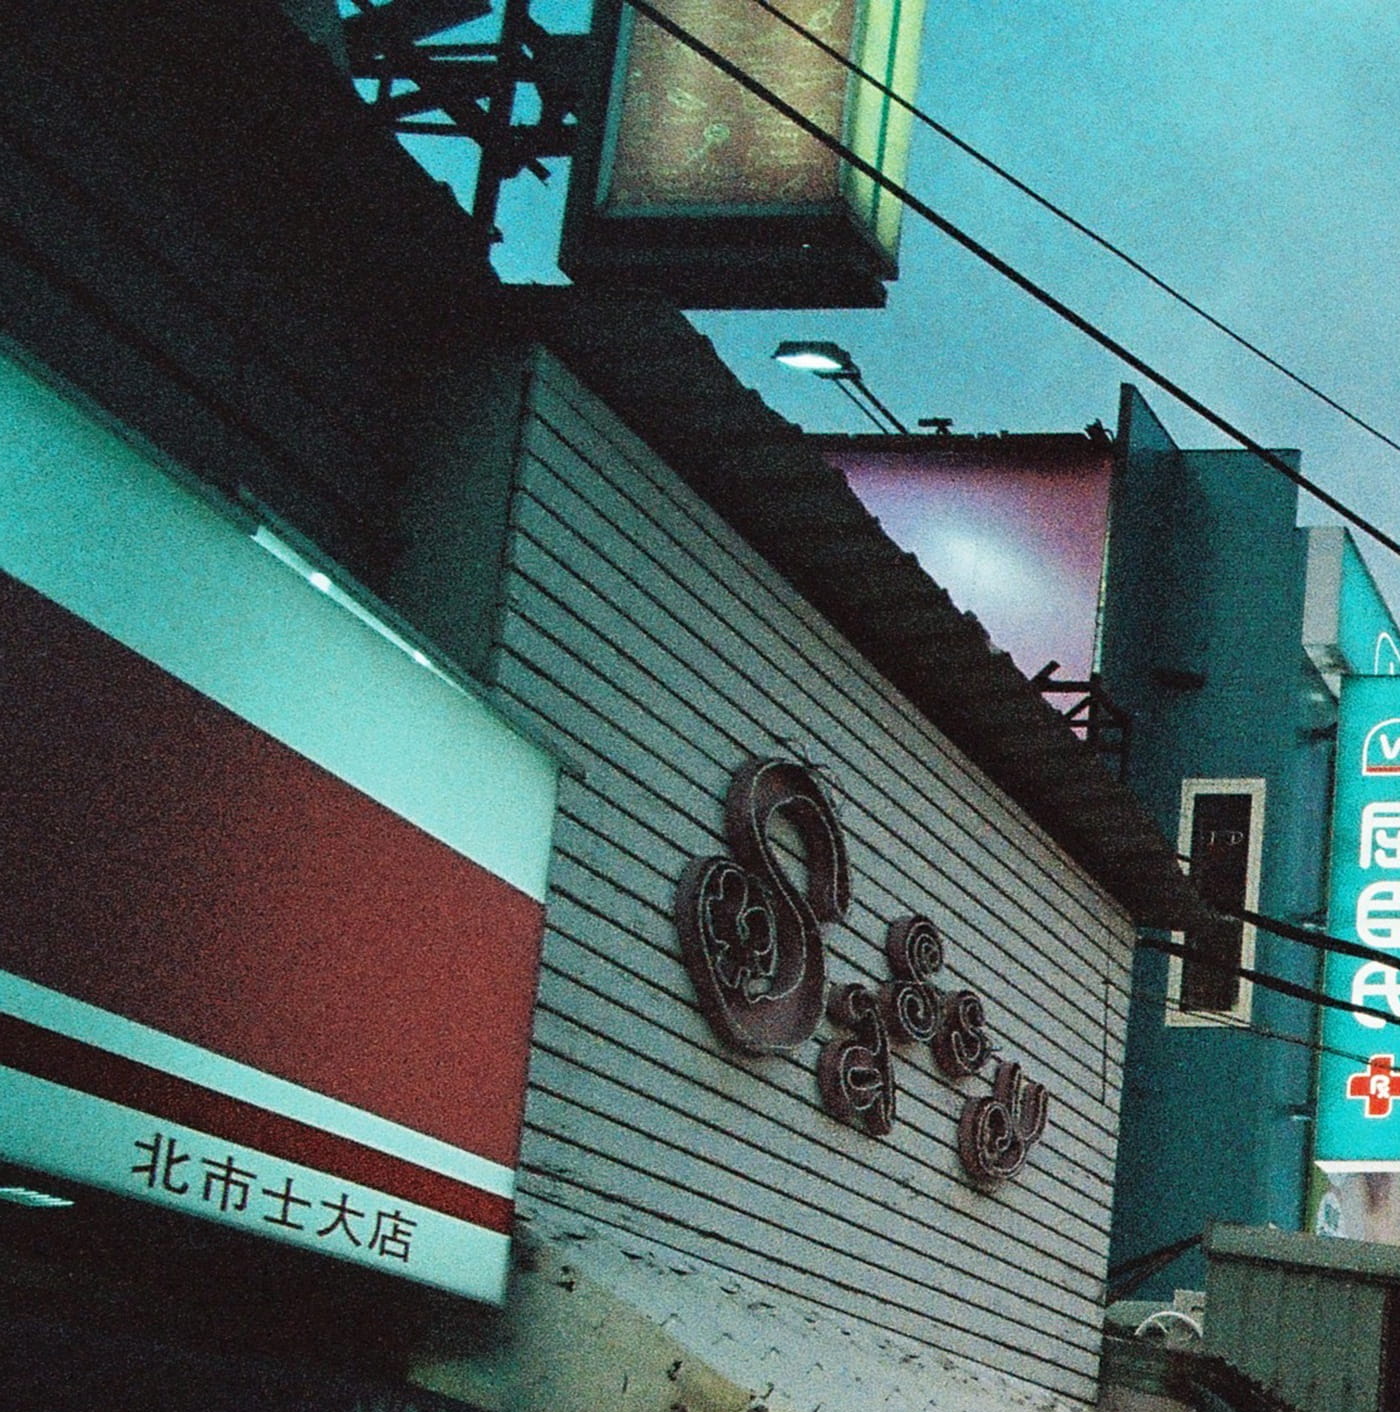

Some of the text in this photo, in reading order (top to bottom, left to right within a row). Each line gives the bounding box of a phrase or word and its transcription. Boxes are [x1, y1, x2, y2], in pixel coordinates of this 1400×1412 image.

[132, 1132, 417, 1264] 北市士大店
